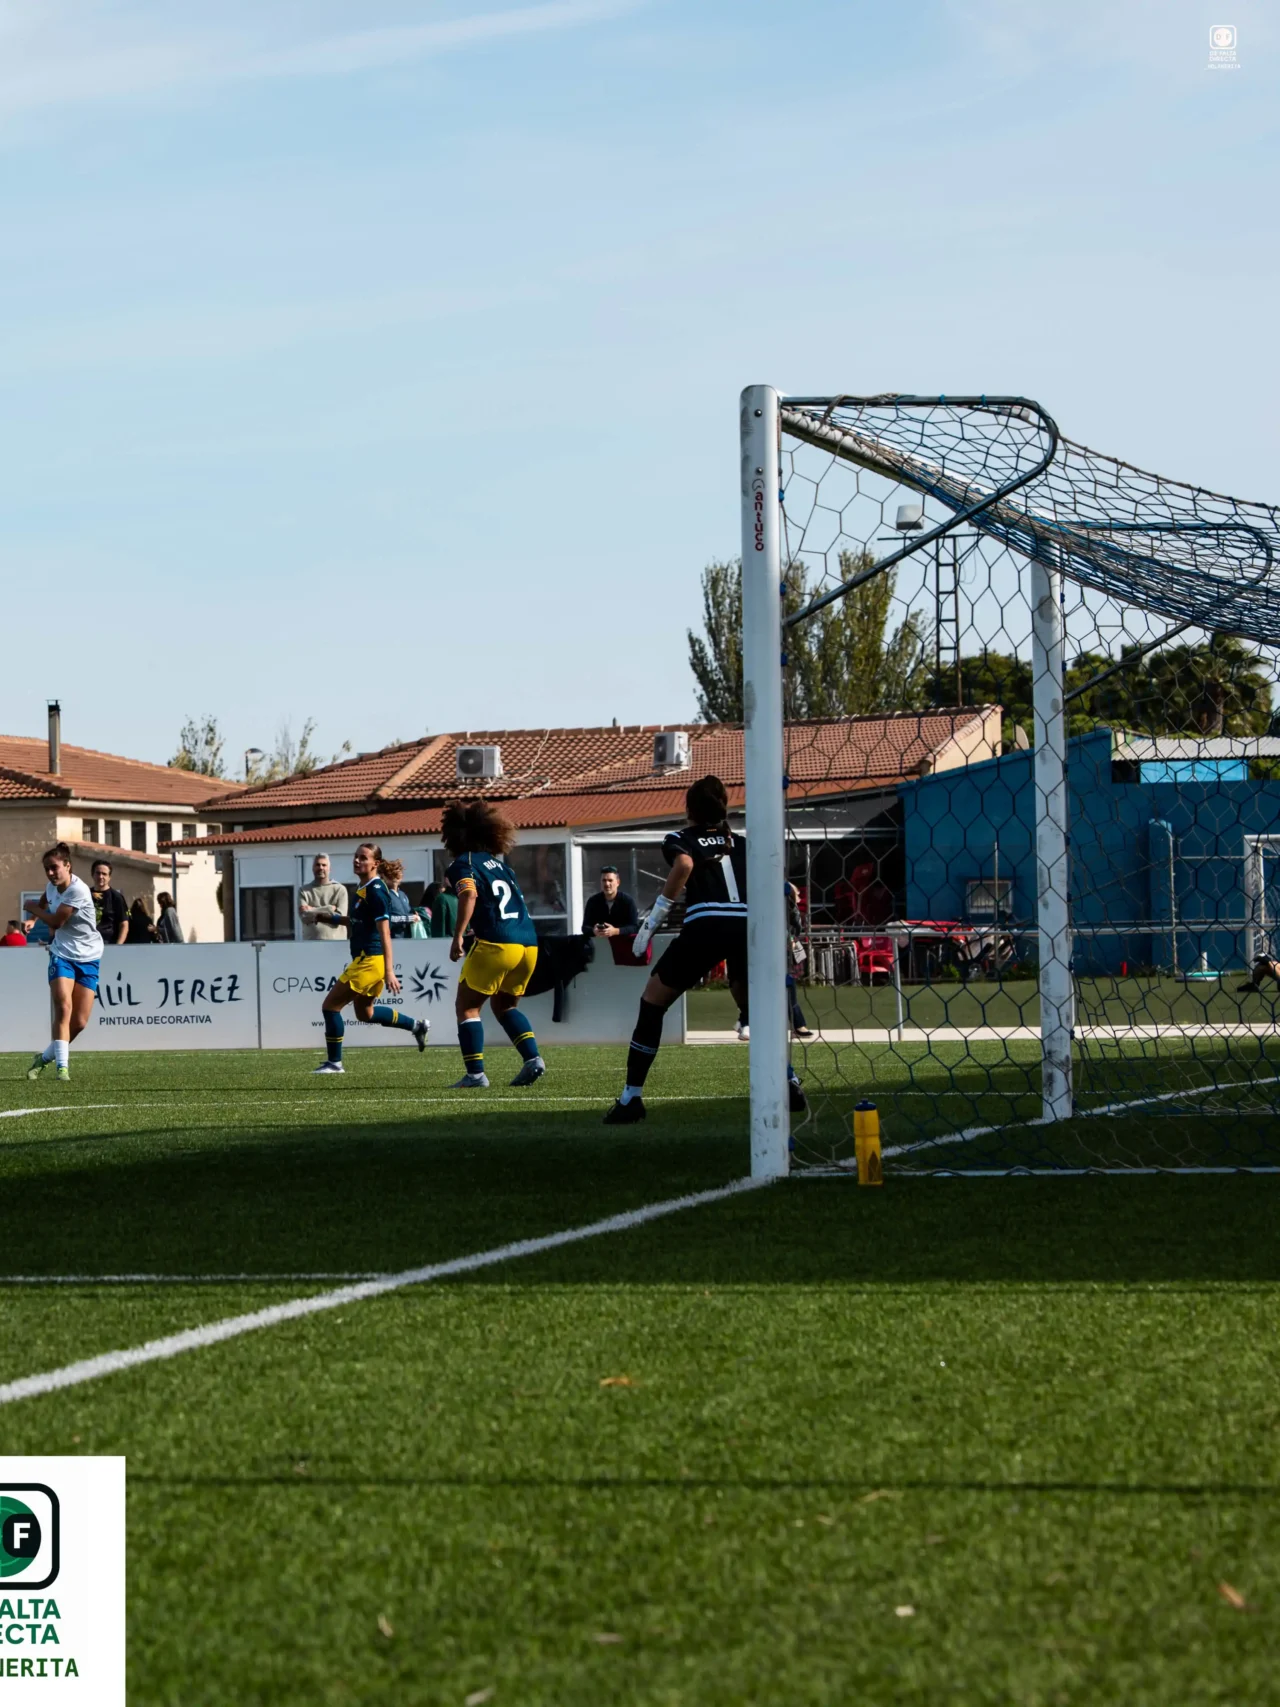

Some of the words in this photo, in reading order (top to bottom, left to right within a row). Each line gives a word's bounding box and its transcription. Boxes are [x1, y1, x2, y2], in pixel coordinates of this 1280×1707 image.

[156, 974, 246, 1009] JEREZ
[99, 1016, 144, 1025] PINTURA
[147, 1015, 212, 1025] DECORATIVA
